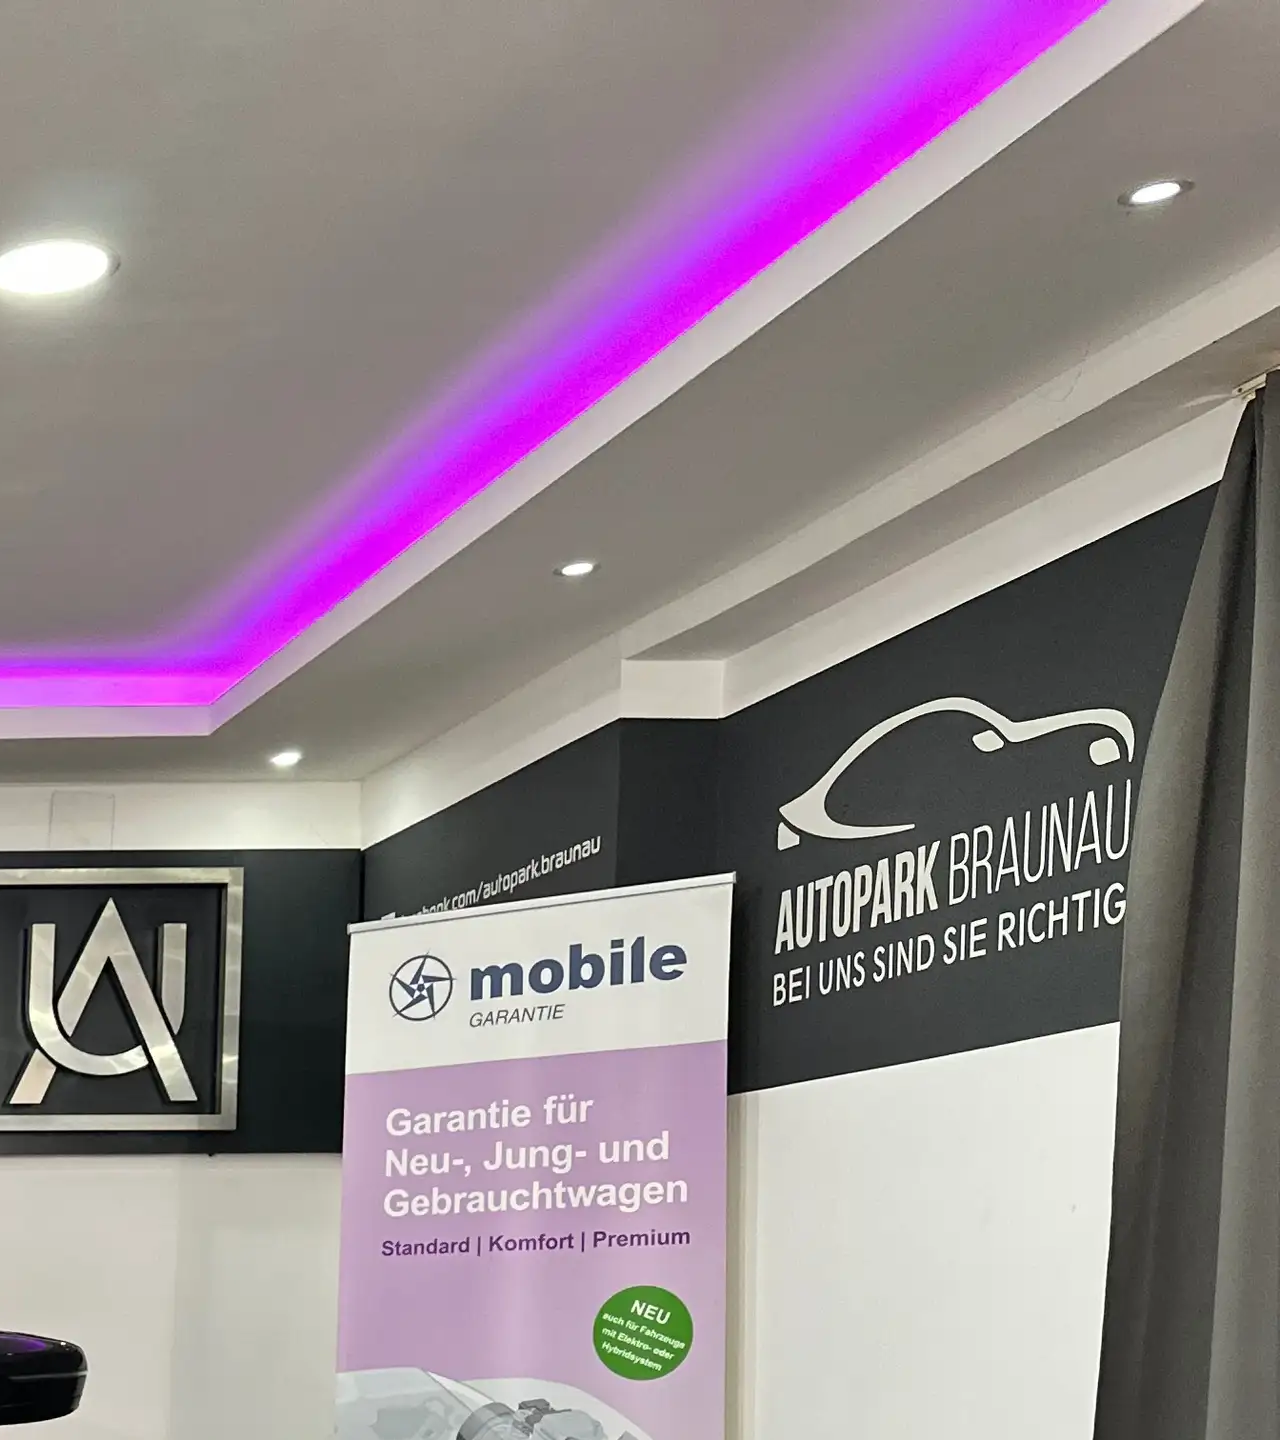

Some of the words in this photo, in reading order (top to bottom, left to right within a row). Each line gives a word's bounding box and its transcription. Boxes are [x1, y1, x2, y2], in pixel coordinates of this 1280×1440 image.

[400, 836, 601, 917] ookcom/autopark.braunau
[774, 840, 940, 956] AUTOPARK
[948, 778, 1132, 906] BRAUNAU
[772, 965, 811, 1007] BEI
[819, 950, 866, 996] UNS
[872, 933, 936, 983] SIND
[942, 916, 988, 965] SIE
[996, 882, 1127, 952] RICHTIG
[470, 936, 688, 1001] mobile
[469, 1004, 566, 1028] GARANTIE
[386, 1099, 532, 1137] Garantie
[543, 1093, 595, 1126] für
[385, 1148, 472, 1178] Neu-,
[483, 1141, 587, 1175] Jung-
[598, 1130, 670, 1164] und
[383, 1178, 689, 1218] Gebrauchtwagen
[381, 1236, 471, 1257] Standard
[488, 1231, 575, 1253] Komfort
[592, 1228, 691, 1249] Premium
[602, 1313, 624, 1326] auch
[639, 1325, 686, 1350] Fahrzeuge
[630, 1299, 671, 1325] NEU
[601, 1327, 617, 1338] mit
[653, 1347, 675, 1360] oder
[601, 1341, 662, 1371] Hybridsystem
